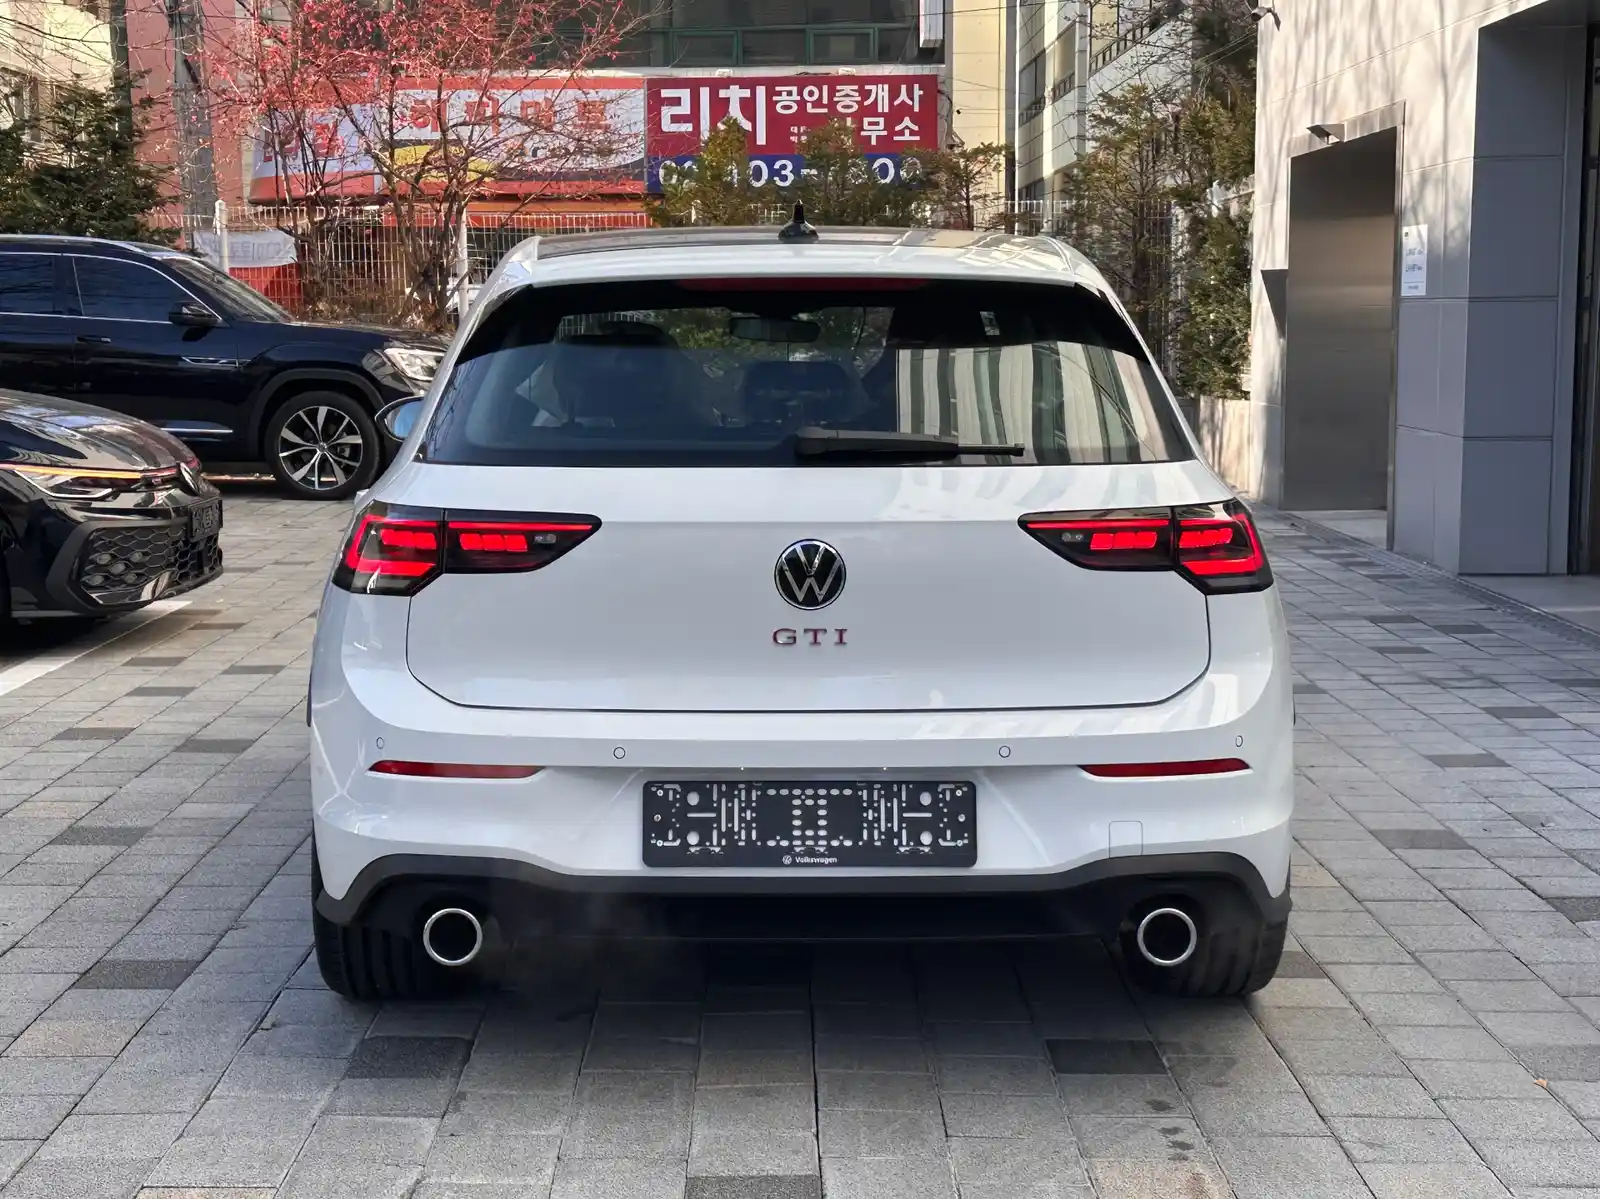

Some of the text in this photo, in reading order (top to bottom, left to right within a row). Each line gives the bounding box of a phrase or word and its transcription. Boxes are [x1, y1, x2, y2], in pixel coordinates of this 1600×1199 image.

[660, 84, 924, 145] 리치 공인중개사
[772, 627, 849, 646] GTI
